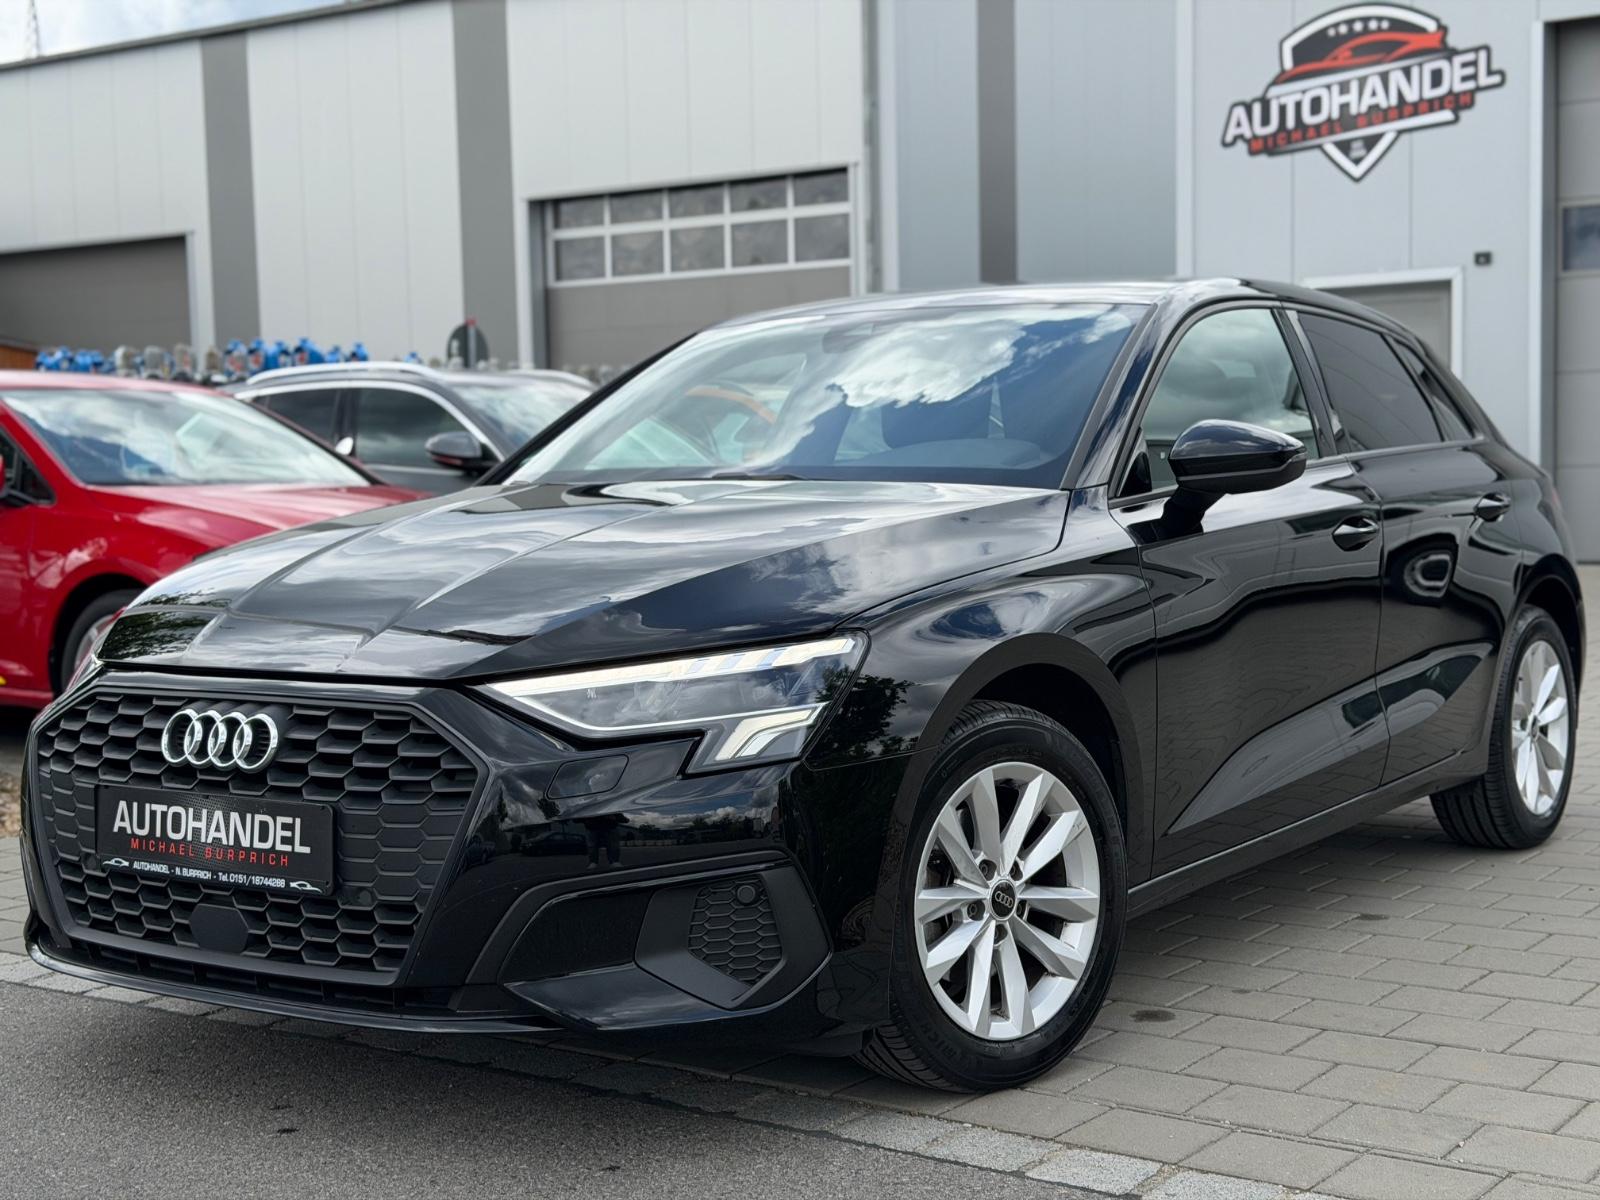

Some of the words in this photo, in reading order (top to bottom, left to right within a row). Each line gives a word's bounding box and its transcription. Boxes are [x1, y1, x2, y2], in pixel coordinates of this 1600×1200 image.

[1223, 49, 1502, 144] AUTOHANDEL
[112, 799, 311, 854] AUTOHANDEL
[130, 837, 195, 857] MICHAEL
[204, 846, 289, 867] BURPRICH
[133, 861, 170, 874] AUTOHANDEL
